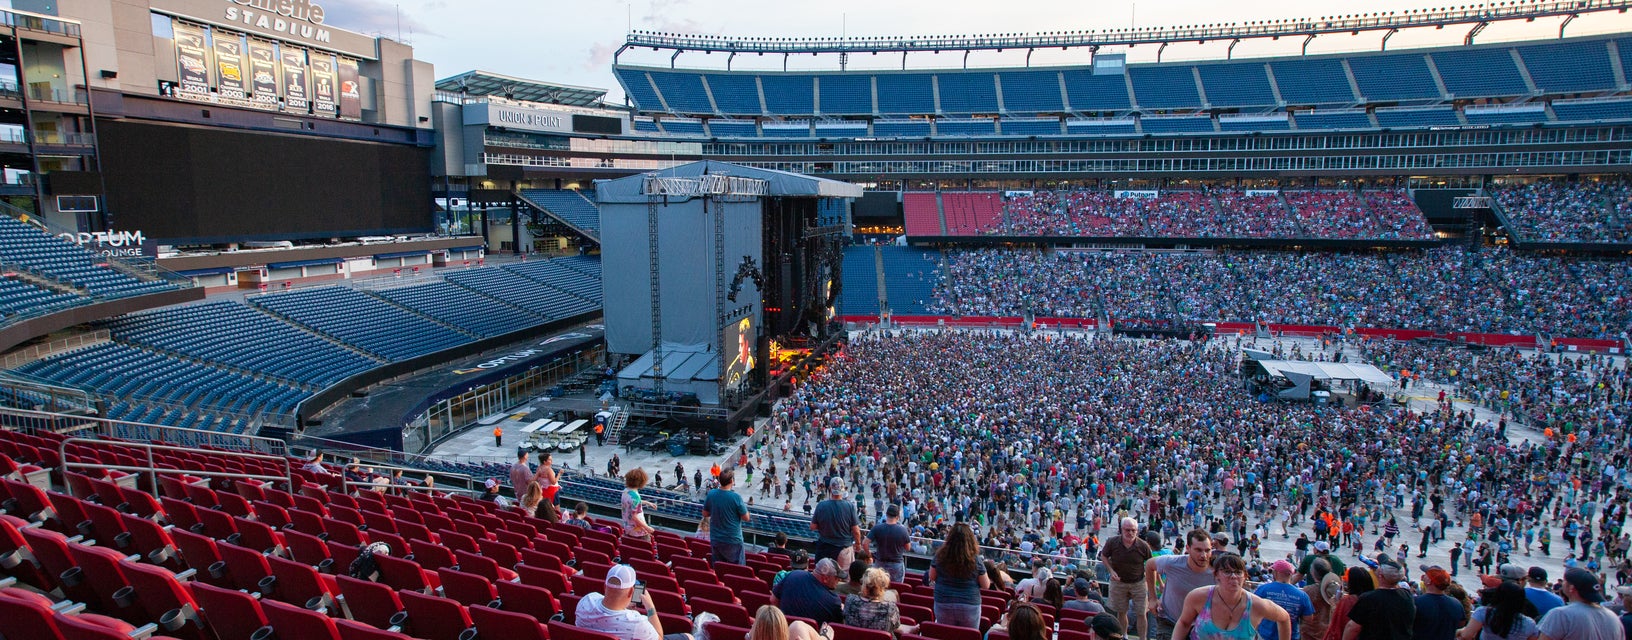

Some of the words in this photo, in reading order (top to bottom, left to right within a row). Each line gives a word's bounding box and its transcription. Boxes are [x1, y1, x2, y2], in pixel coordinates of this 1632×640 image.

[225, 7, 330, 43] STADIUM
[184, 84, 207, 94] 2001
[221, 89, 244, 99] 2003
[255, 94, 277, 104] 2004
[288, 99, 306, 108] 2014
[317, 103, 334, 111] 2016
[499, 110, 526, 124] UNION
[535, 115, 563, 128] POINT
[101, 248, 142, 257] OUNGE
[477, 348, 544, 369] OPTUM
